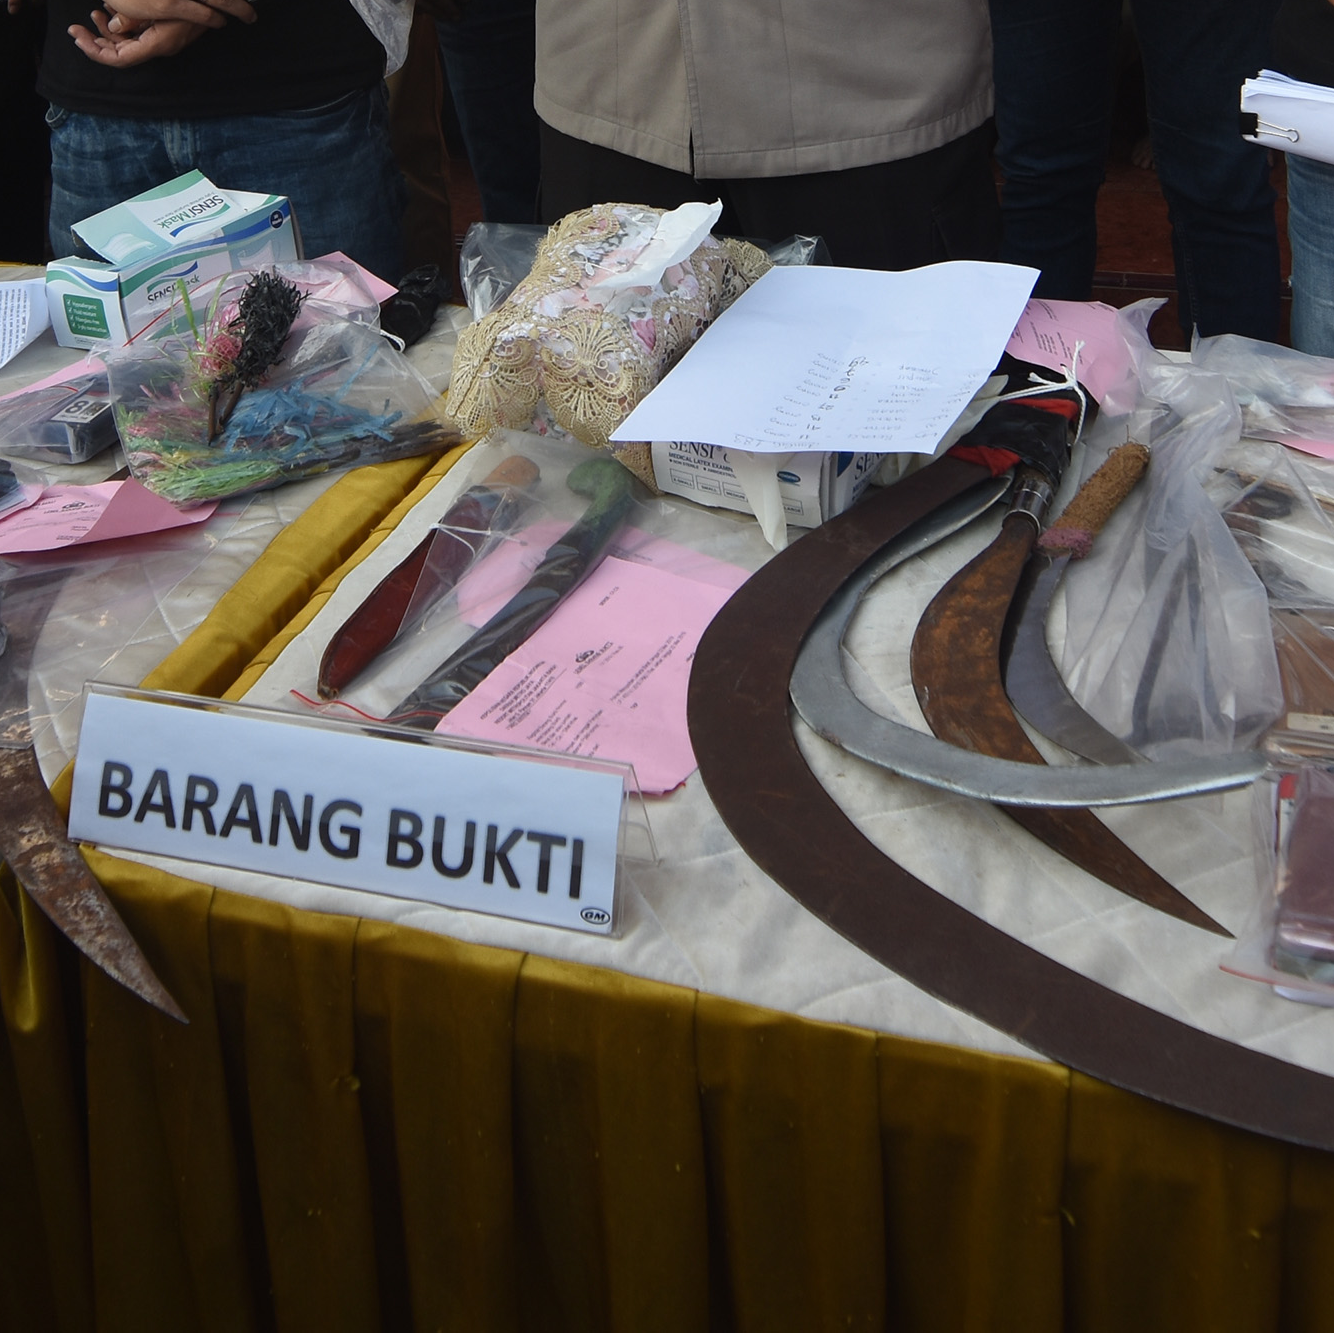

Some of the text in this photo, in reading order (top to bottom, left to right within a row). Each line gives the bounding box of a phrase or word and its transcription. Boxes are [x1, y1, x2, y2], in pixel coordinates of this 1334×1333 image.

[98, 760, 586, 901] BARANG BUKTI
[583, 908, 608, 925] GM
